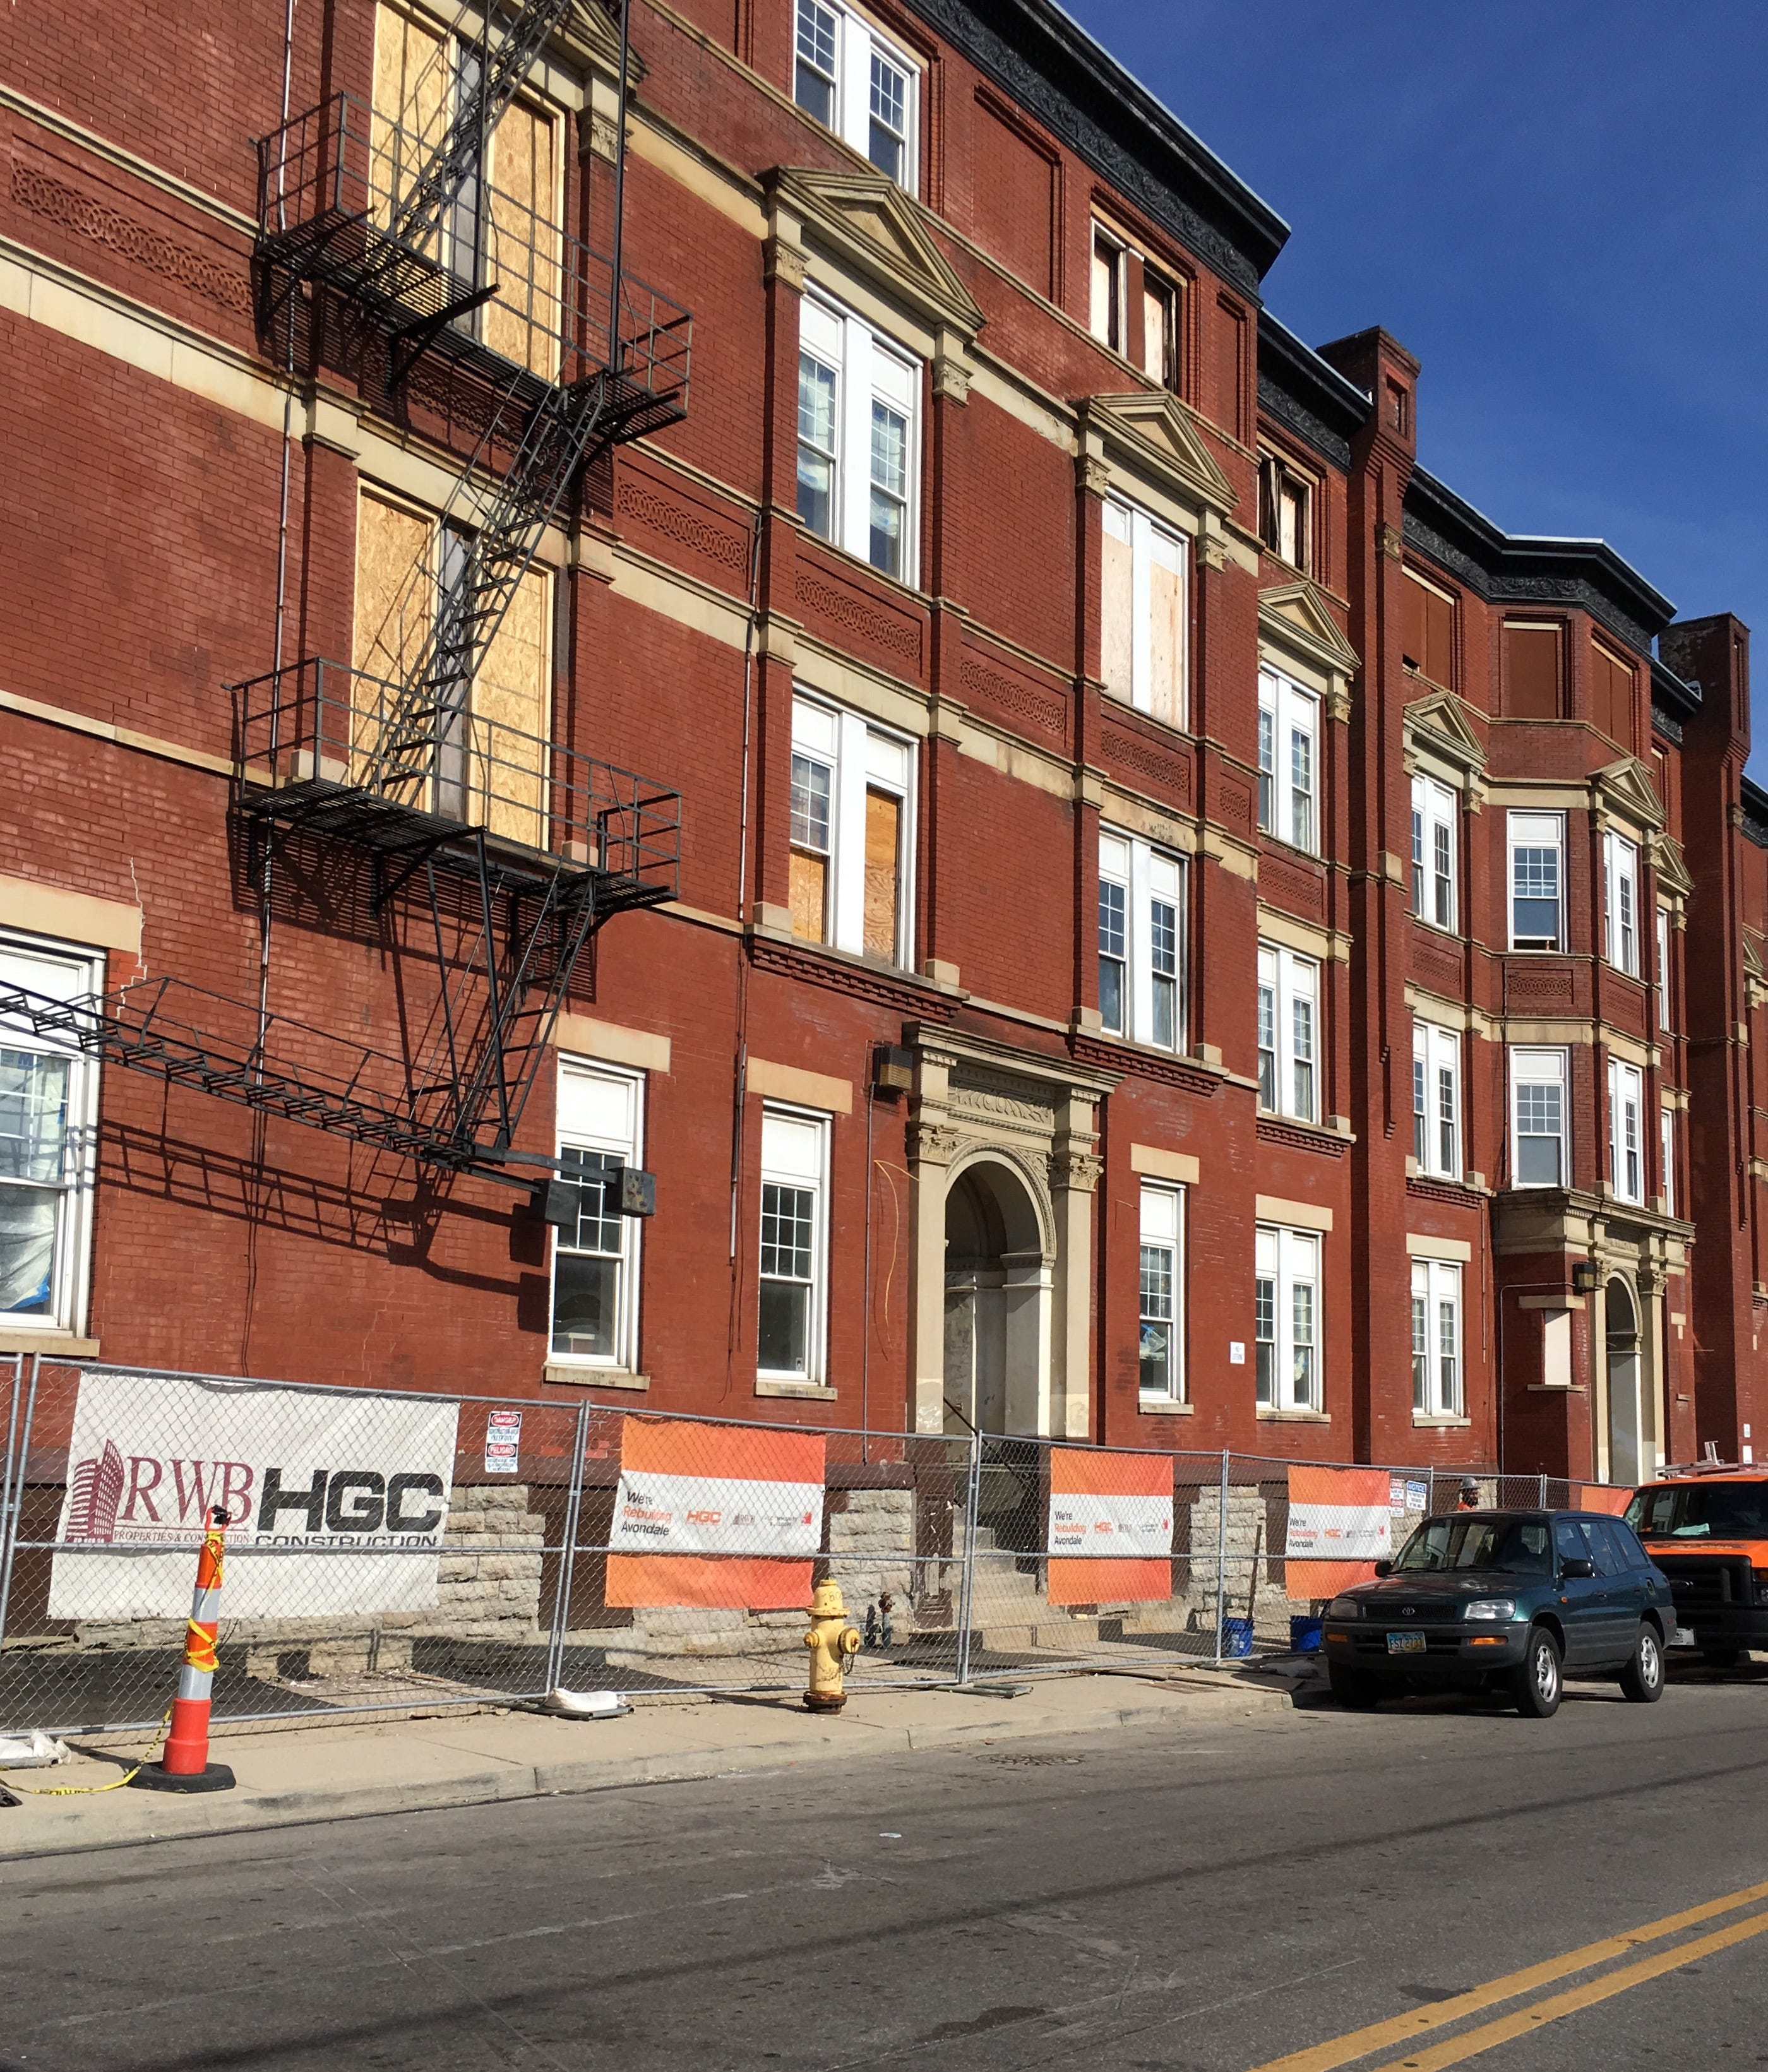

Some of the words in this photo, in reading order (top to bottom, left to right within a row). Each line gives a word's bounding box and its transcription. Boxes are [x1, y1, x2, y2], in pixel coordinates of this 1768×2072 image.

[490, 1446, 513, 1455] PELIGRO
[117, 1456, 254, 1525] RWB
[257, 1467, 443, 1532] HGC
[627, 1491, 652, 1505] We're
[686, 1509, 722, 1523] HGC
[1055, 1511, 1073, 1520] We're
[621, 1521, 669, 1535] Avondale
[1289, 1518, 1306, 1526] We're
[1054, 1523, 1086, 1534] Rebuilding
[114, 1530, 174, 1542] PROPERTIES
[184, 1533, 250, 1543] CONSCTION
[255, 1535, 438, 1546] CONSTRUCTION
[1054, 1535, 1082, 1545] Avondale
